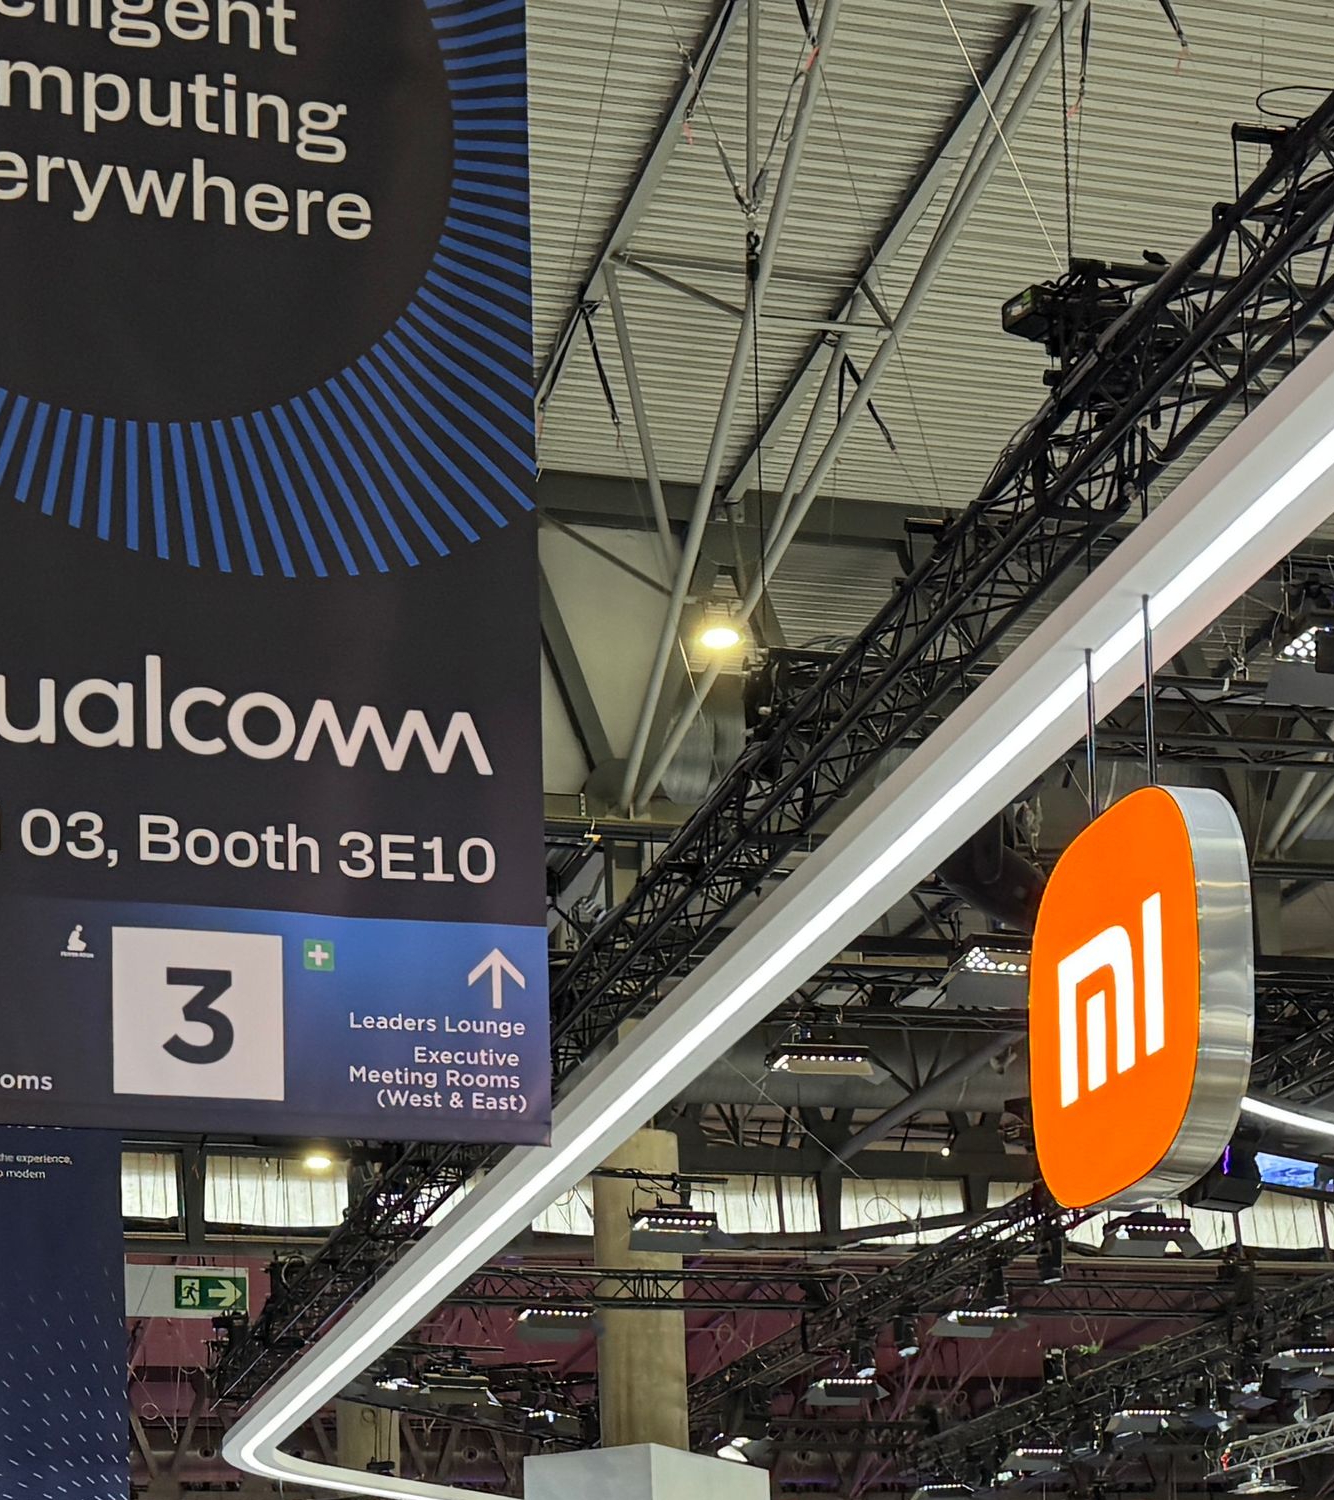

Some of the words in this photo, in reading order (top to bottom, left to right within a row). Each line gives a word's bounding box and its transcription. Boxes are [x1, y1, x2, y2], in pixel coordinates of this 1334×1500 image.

[20, 808, 118, 868] 03,
[139, 814, 320, 874] Booth
[339, 831, 496, 884] 3E10
[163, 966, 234, 1065] 3
[349, 1011, 437, 1032] Leaders
[444, 1015, 526, 1038] Lounge
[414, 1046, 520, 1067] Executive
[349, 1065, 438, 1088] Meeting
[446, 1069, 520, 1089] Rooms
[376, 1089, 442, 1109] (West
[449, 1092, 464, 1108] &
[472, 1092, 528, 1113] East)
